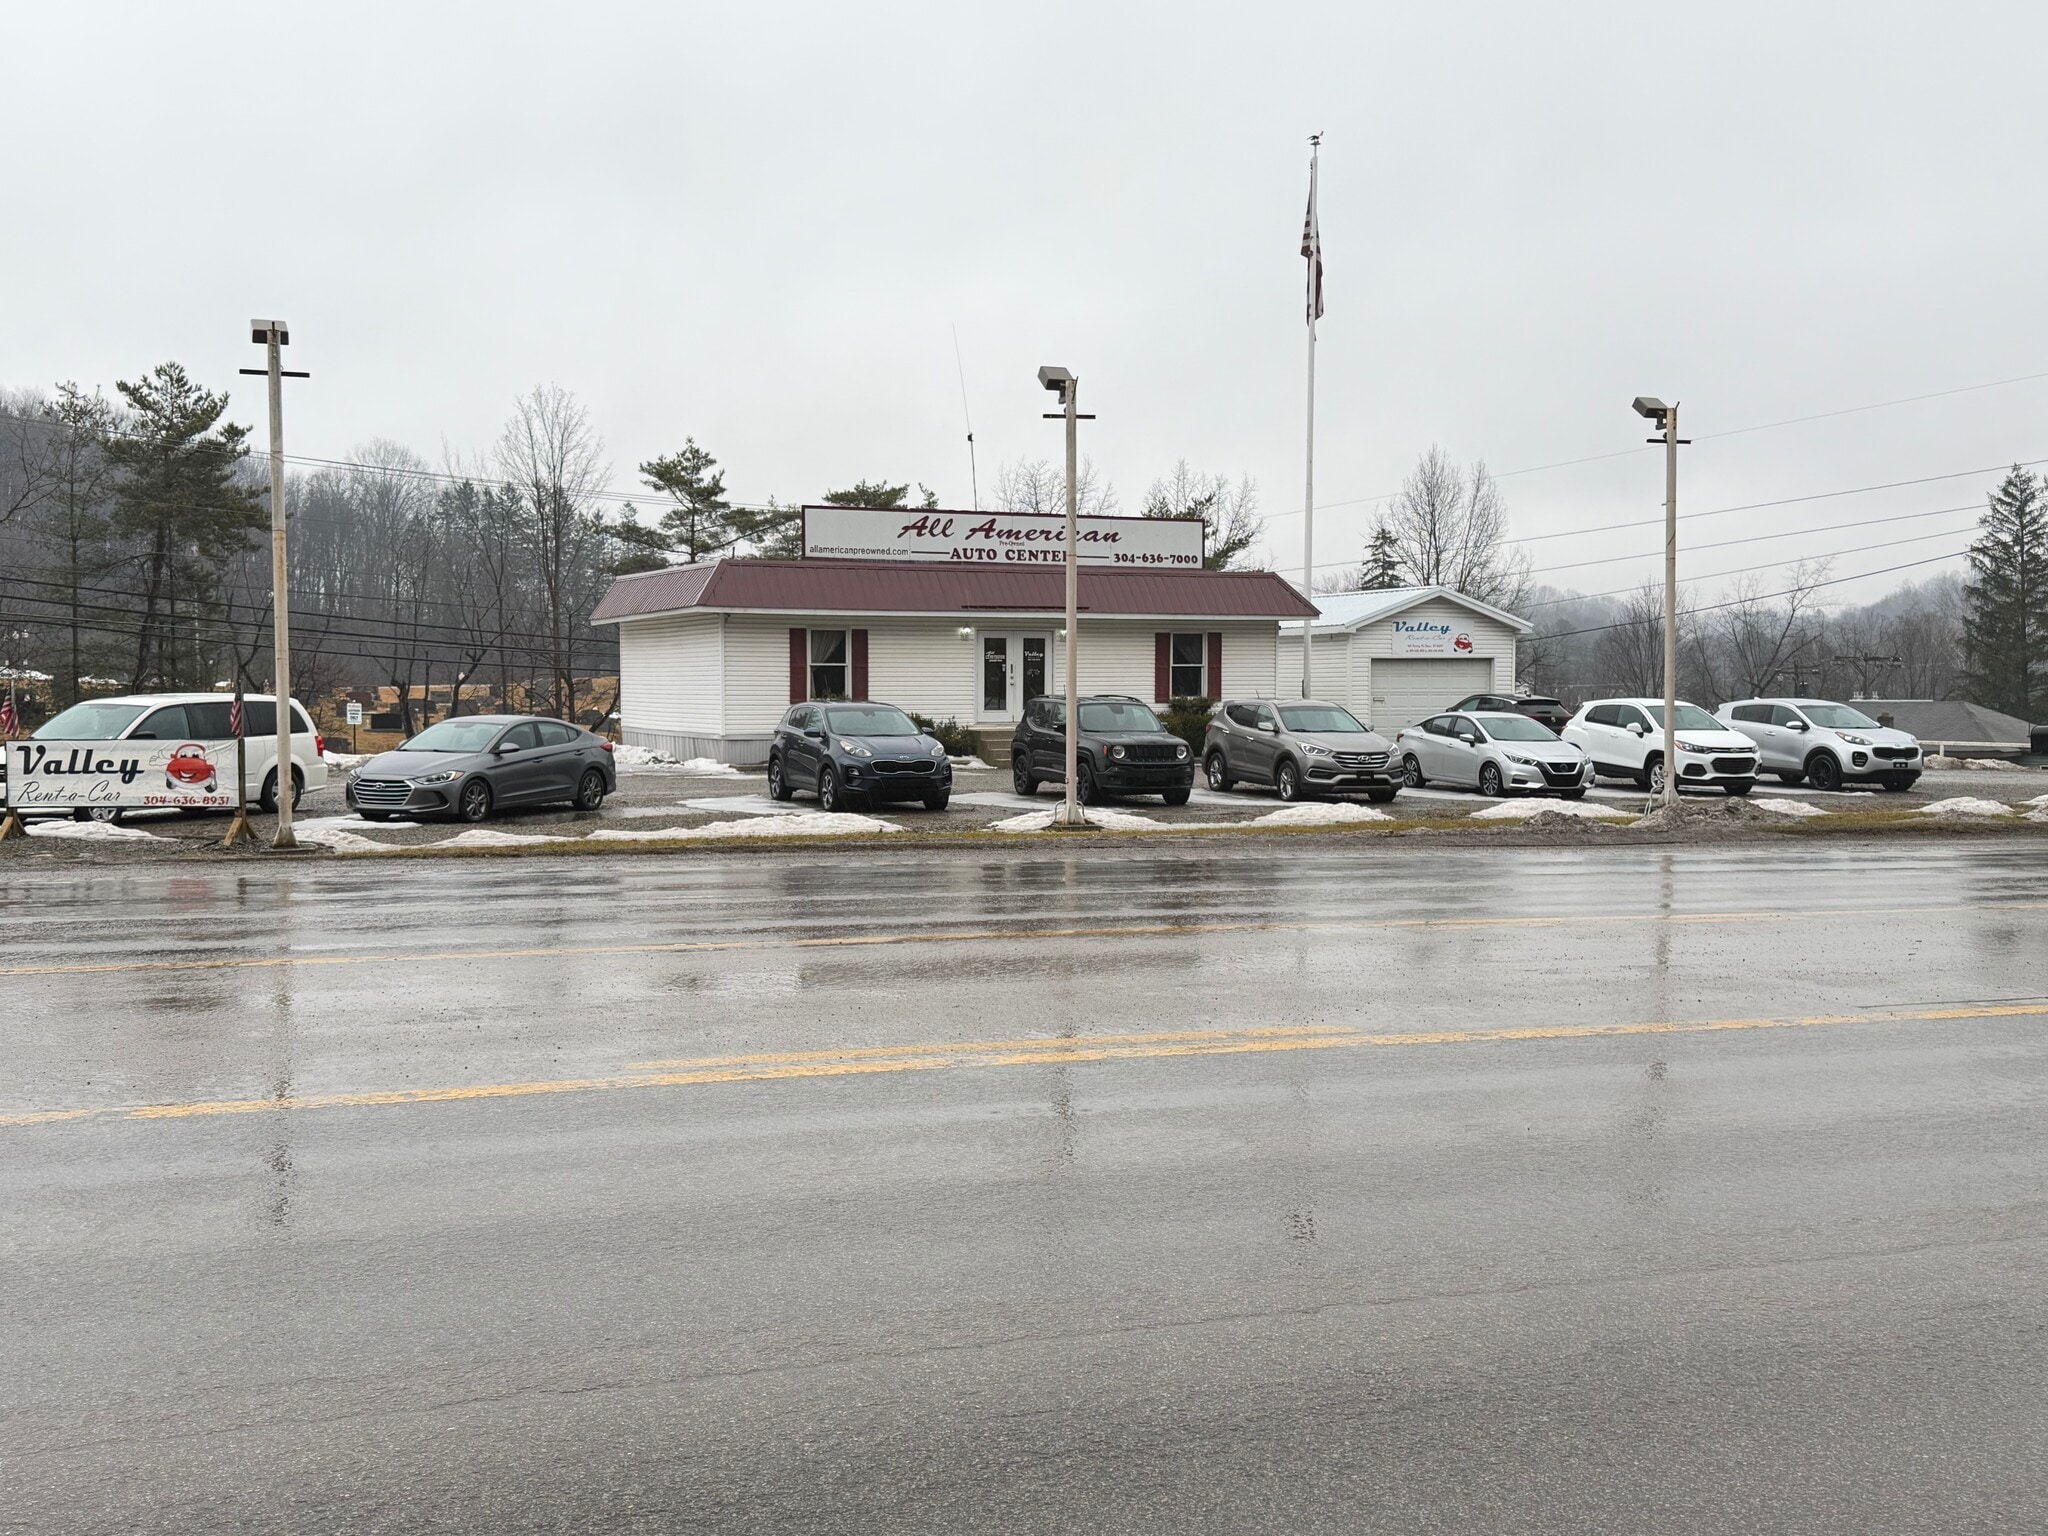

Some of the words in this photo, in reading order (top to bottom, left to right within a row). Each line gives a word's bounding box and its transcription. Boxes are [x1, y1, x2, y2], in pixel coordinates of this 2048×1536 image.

[897, 515, 954, 538] All
[965, 518, 1122, 543] Amerian
[809, 545, 909, 556] allamericanpreowned.com
[950, 547, 997, 560] AUTO
[1113, 553, 1199, 564] 304-636-7000
[1392, 621, 1451, 634] Valley
[16, 745, 145, 784] Valley
[17, 780, 121, 802] Rent-a-Car
[143, 796, 230, 805] 304-636-8931
